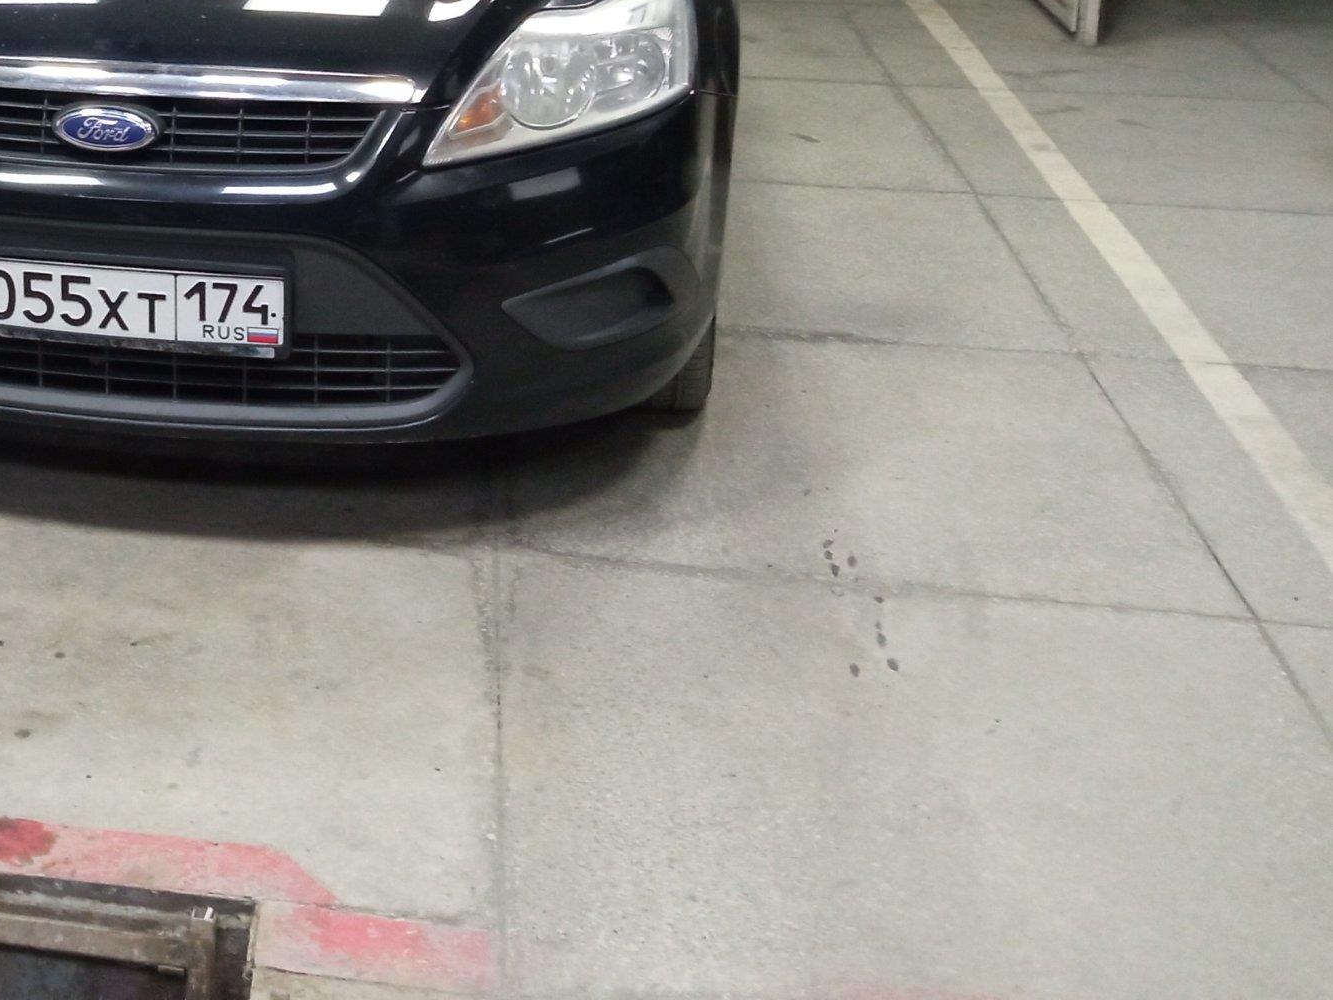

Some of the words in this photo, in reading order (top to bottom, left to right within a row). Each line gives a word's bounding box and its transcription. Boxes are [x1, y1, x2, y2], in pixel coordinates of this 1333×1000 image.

[76, 116, 129, 143] Ford
[183, 281, 269, 325] 174
[202, 324, 245, 341] RUS
